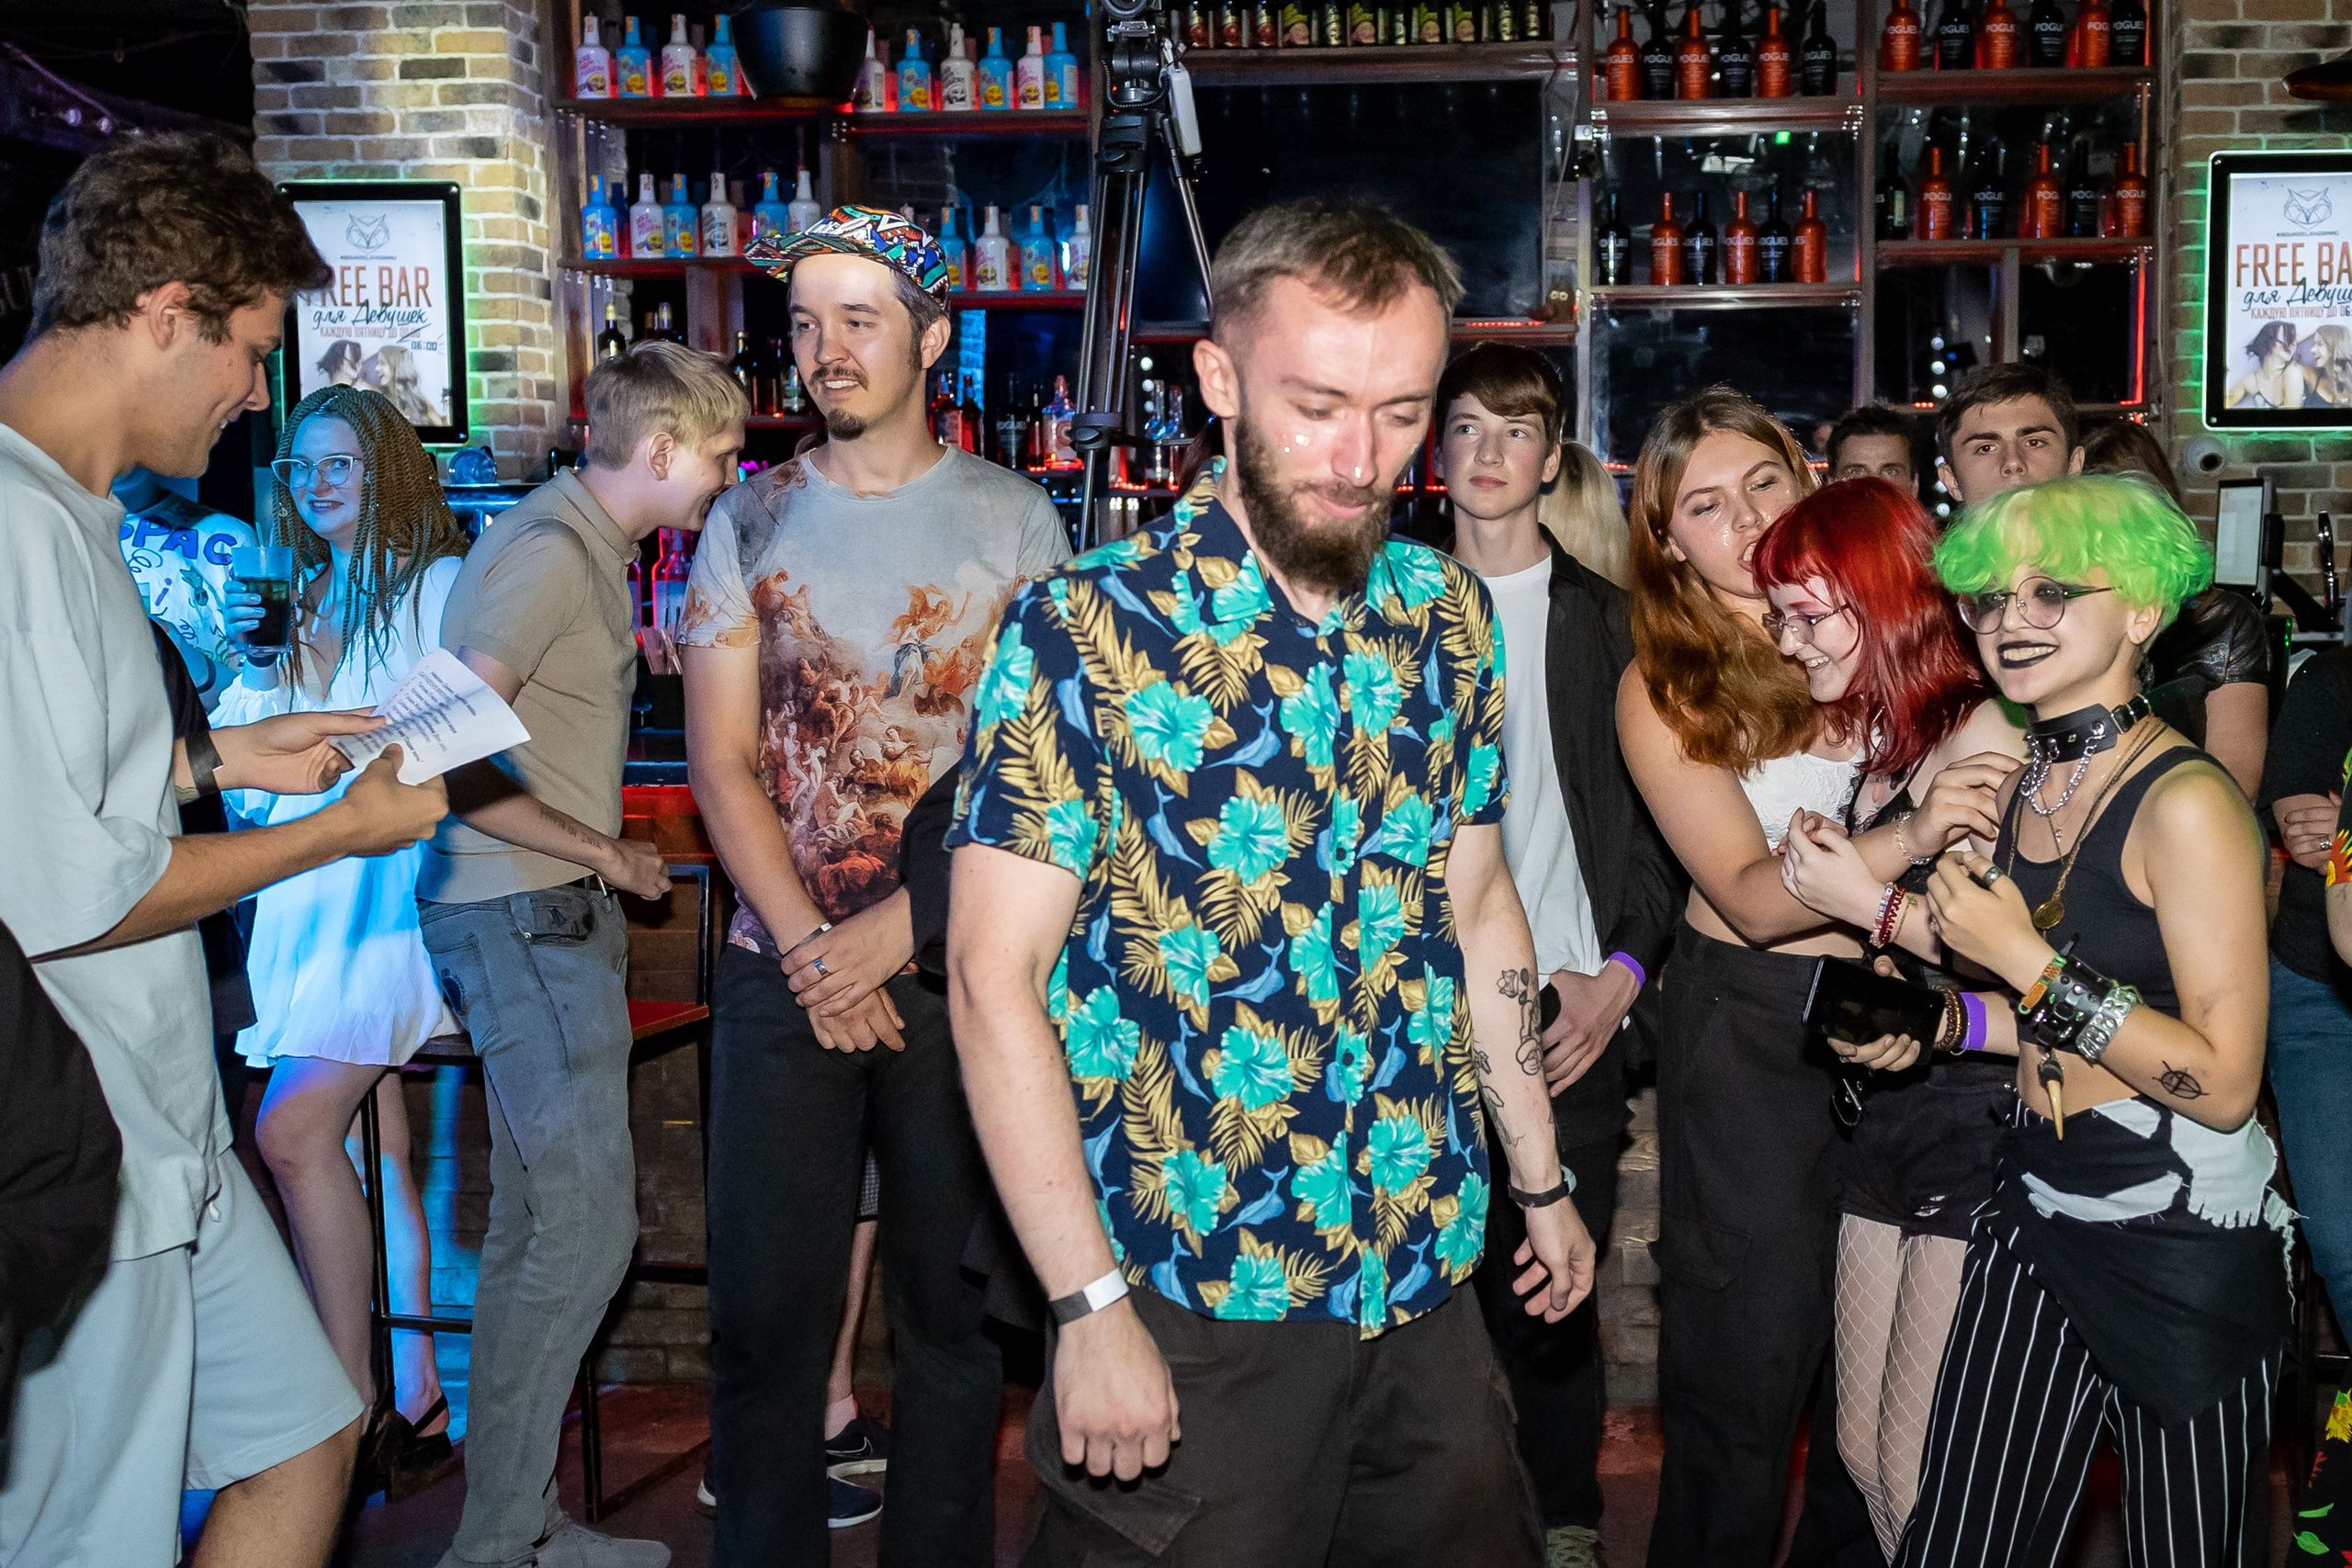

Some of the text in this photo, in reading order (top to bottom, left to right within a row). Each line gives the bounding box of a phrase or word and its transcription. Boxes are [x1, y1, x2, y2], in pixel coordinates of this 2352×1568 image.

[2236, 242, 2352, 287] FREE BA
[306, 265, 432, 307] EE BAR
[2242, 289, 2281, 311] для
[311, 309, 346, 330] для
[2250, 307, 2287, 320] КАЖДУЮ
[2289, 306, 2324, 319] ПЯТНИЦУ
